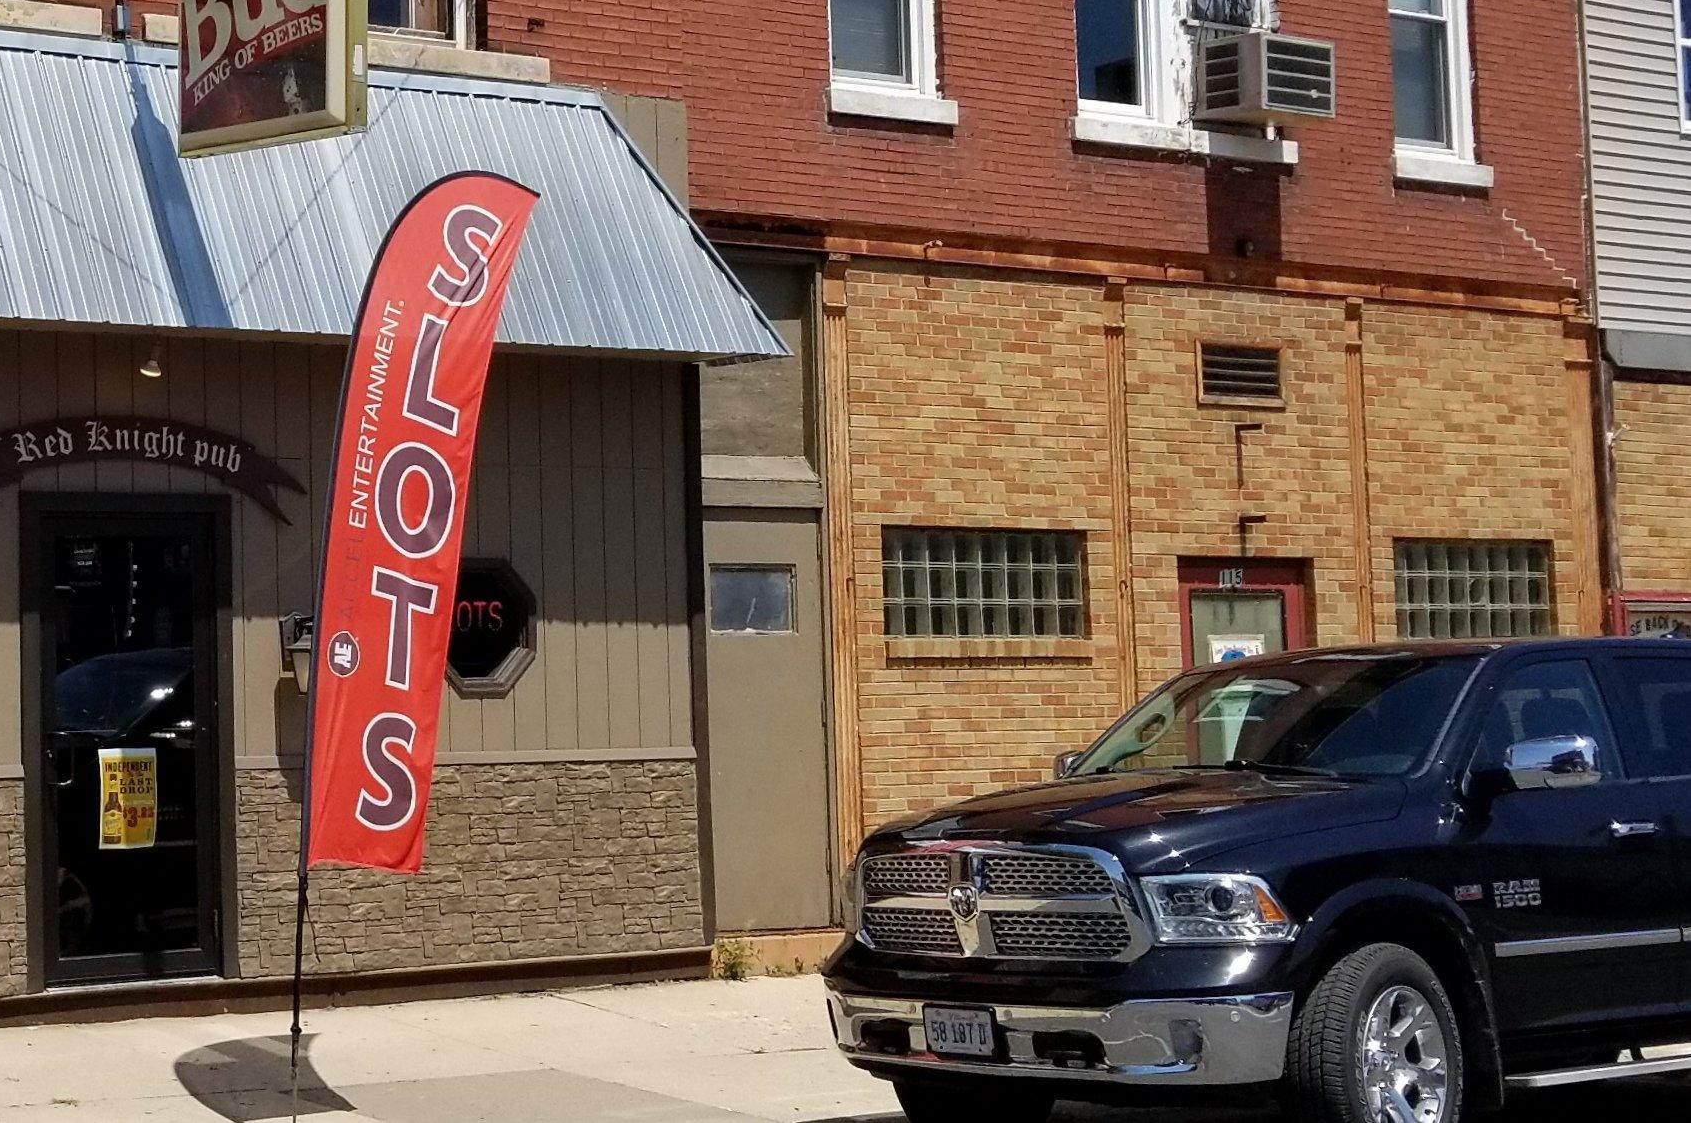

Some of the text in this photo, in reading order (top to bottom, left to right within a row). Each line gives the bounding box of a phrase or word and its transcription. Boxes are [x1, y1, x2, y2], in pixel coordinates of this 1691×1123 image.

[192, 14, 324, 106] KING OF BEERS
[11, 420, 242, 474] Red Knight pub
[354, 203, 504, 832] SLOTS
[1221, 568, 1243, 586] 115
[456, 600, 503, 632] OTS
[119, 777, 153, 786] LAST
[119, 786, 153, 795] DROP
[1492, 878, 1541, 895] RAM
[1494, 893, 1542, 908] 1500
[931, 1020, 947, 1043] 58
[951, 1022, 974, 1045] 187
